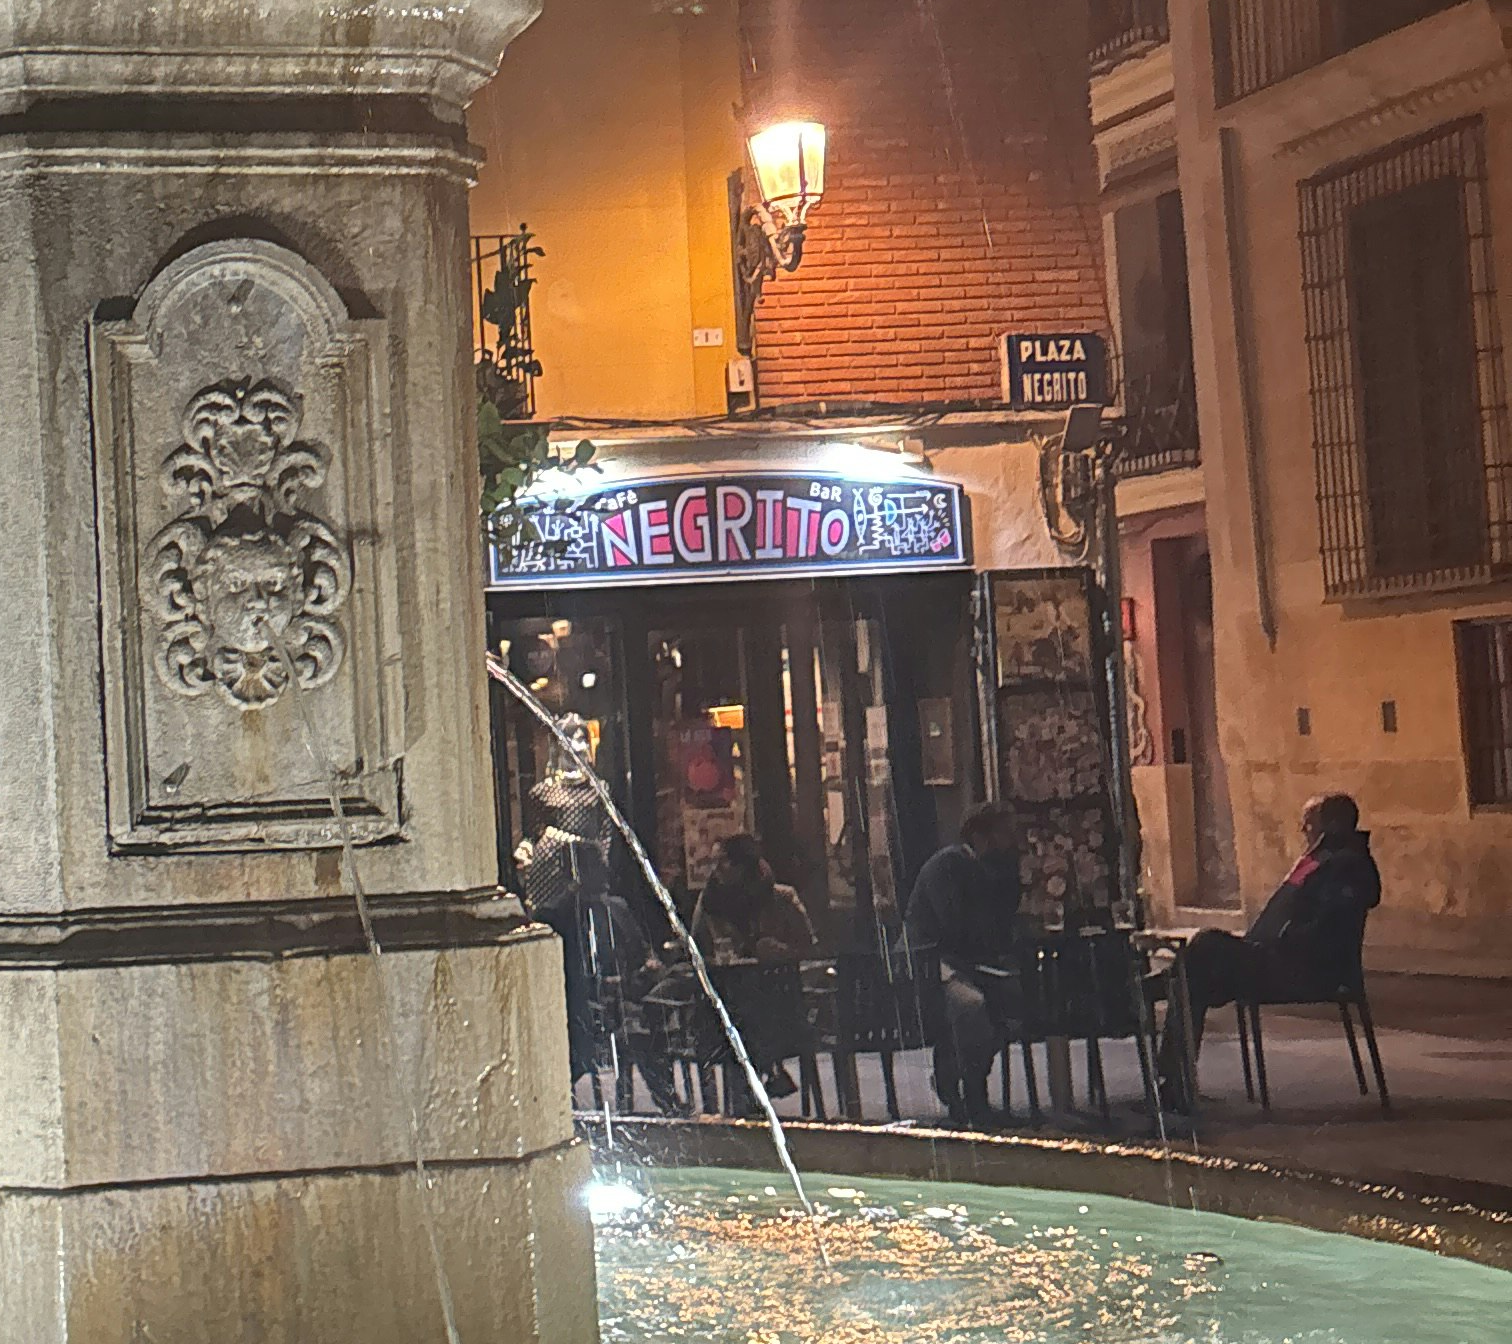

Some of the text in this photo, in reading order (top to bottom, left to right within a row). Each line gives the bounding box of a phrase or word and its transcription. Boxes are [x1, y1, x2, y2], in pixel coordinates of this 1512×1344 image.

[1020, 339, 1087, 363] PLAZA
[1022, 371, 1088, 404] NEGRITO
[600, 485, 850, 568] NEGRITO
